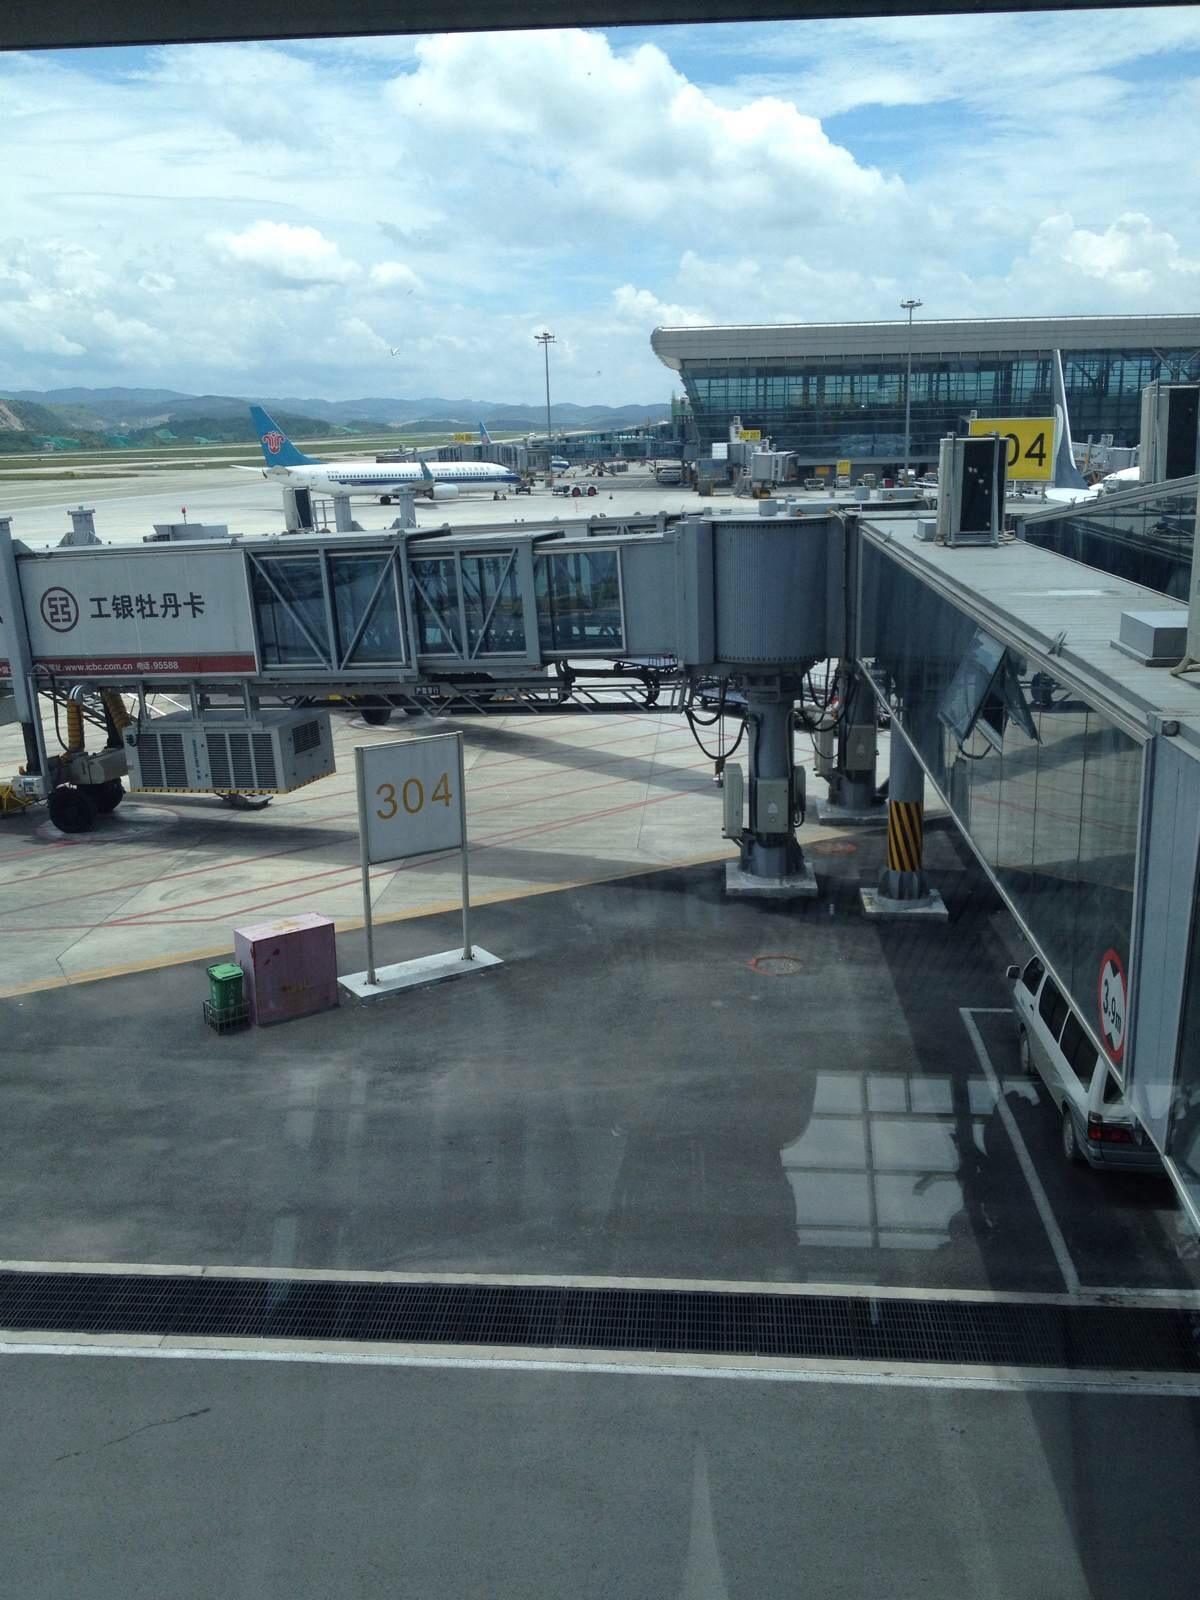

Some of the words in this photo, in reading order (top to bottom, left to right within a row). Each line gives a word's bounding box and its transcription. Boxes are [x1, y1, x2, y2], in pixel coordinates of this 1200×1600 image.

[1004, 432, 1047, 468] 04
[89, 591, 205, 620] 工银牡丹卡
[376, 772, 453, 820] 304
[1102, 978, 1122, 1034] 3.9m
